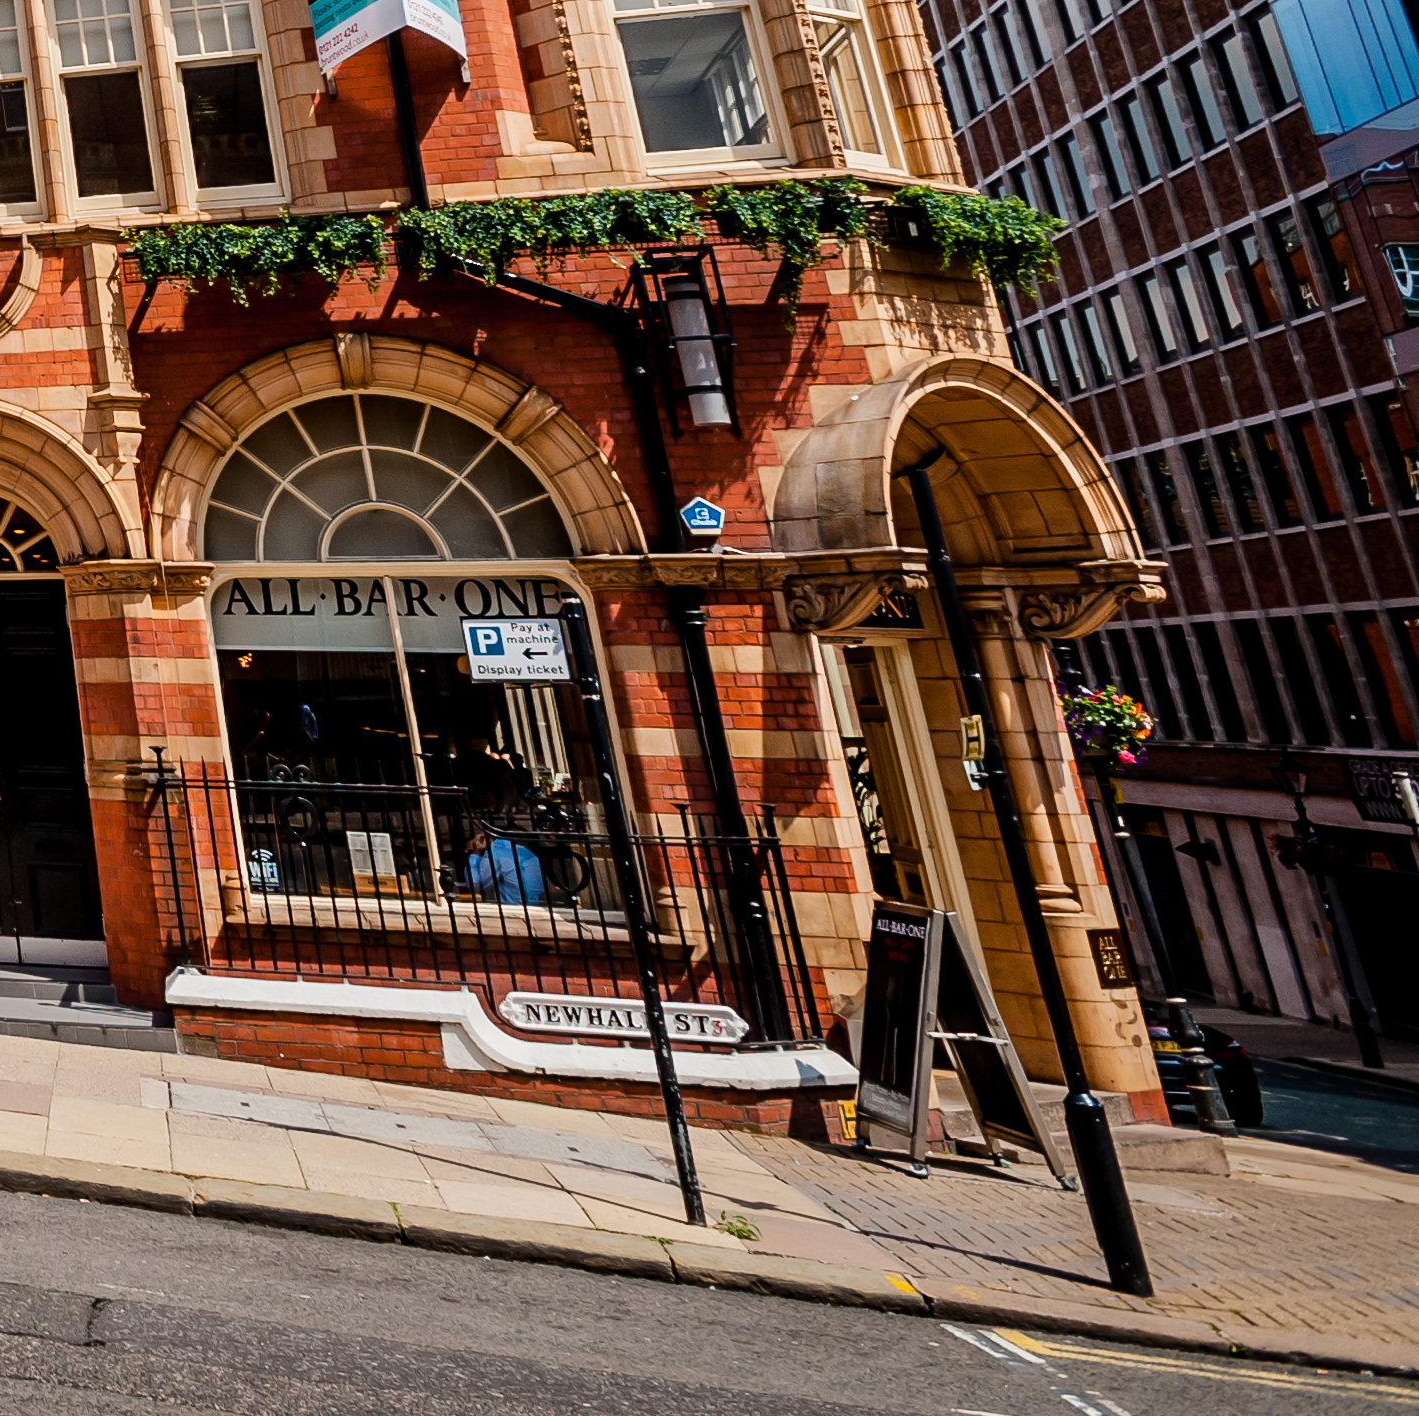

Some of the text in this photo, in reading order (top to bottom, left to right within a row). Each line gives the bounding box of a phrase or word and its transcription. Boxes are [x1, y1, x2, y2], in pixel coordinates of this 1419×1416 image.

[332, 32, 343, 49] 222
[343, 23, 359, 40] 4242
[223, 579, 565, 618] ALL BAR ONE
[510, 622, 533, 634] Pay
[537, 623, 550, 632] at
[506, 634, 559, 645] machine
[477, 663, 565, 677] Display ticket
[876, 919, 926, 940] ALL BAR ONE
[1098, 936, 1118, 950] ALL
[1100, 951, 1122, 964] BAR
[1103, 966, 1128, 979] ONE
[525, 1003, 723, 1035] NEWHAL ST 3
